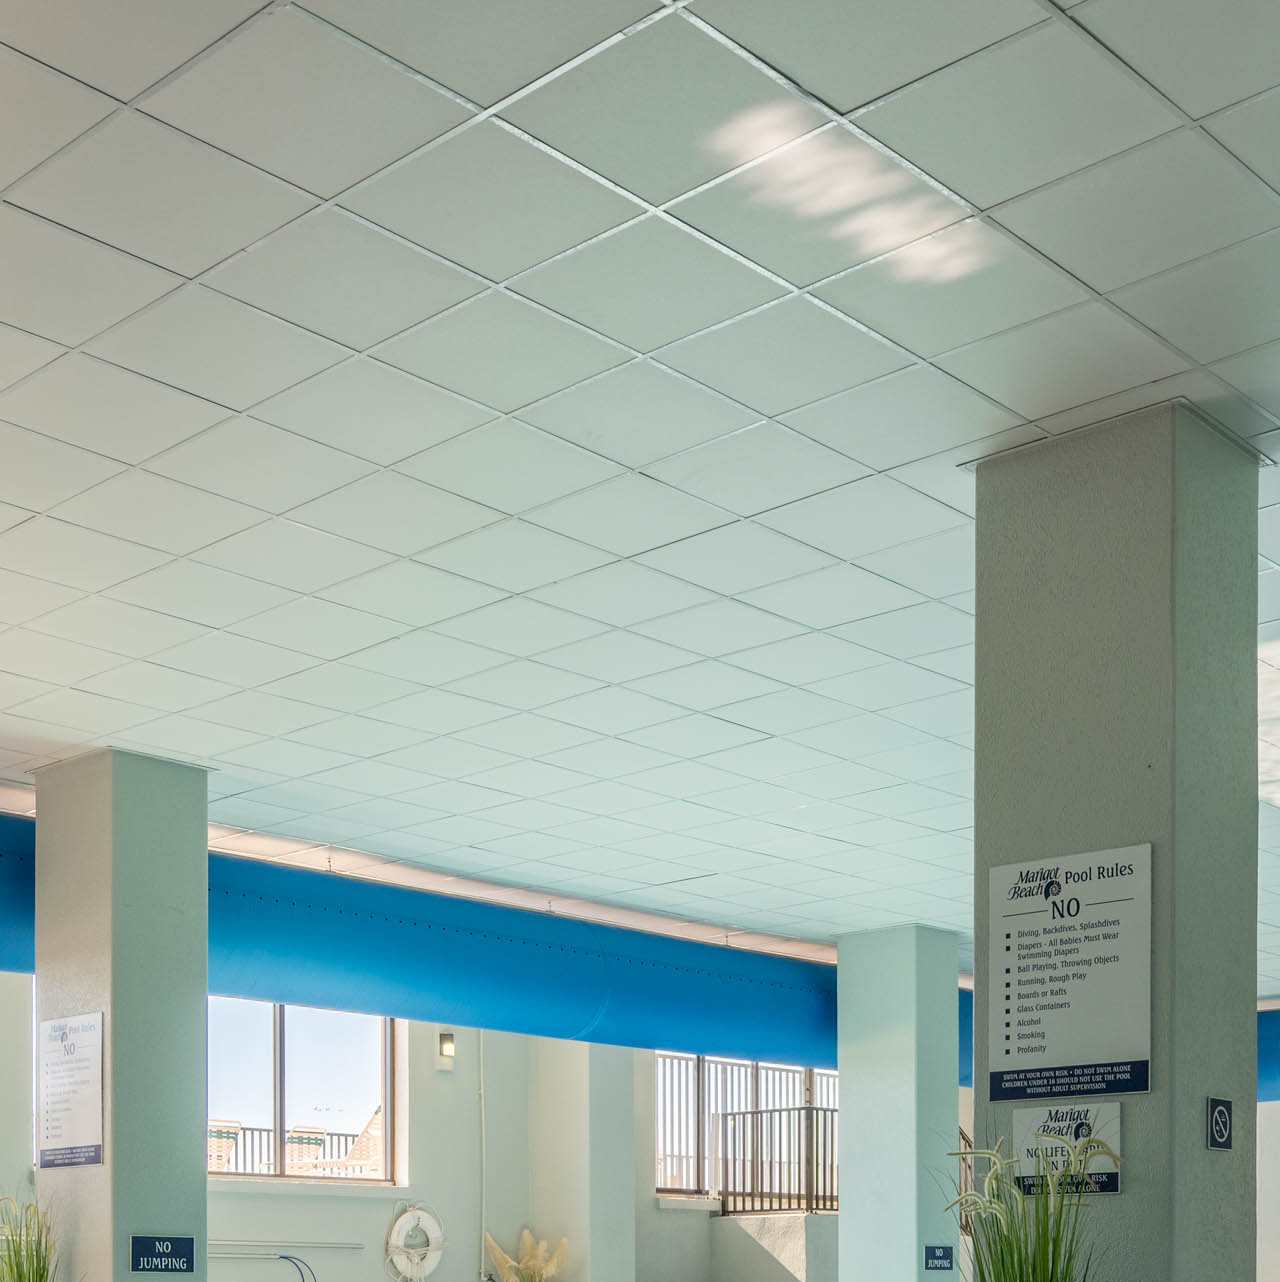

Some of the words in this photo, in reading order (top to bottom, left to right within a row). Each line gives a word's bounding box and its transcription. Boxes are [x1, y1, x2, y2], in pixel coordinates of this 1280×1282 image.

[1013, 866, 1060, 886] Marigot
[1064, 866, 1092, 884] Pool
[1097, 862, 1134, 880] Rules
[1005, 882, 1044, 901] Beach
[1051, 897, 1080, 919] NO
[1079, 919, 1120, 931] Splashdives
[1017, 941, 1042, 952] Diapers
[1048, 937, 1058, 947] All
[1059, 936, 1082, 946] Babies
[1083, 933, 1100, 943] Must
[1101, 931, 1119, 941] Wear
[1017, 950, 1052, 961] Swimming
[1054, 946, 1080, 957] Diapers
[1017, 964, 1030, 974] Ball
[1061, 957, 1092, 969] Throwing
[1094, 954, 1120, 965] Objects
[1048, 972, 1070, 983] Rough
[1072, 971, 1087, 981] Play
[1017, 990, 1040, 1000] Boards
[1050, 987, 1067, 997] Rafts
[1017, 1005, 1034, 1014] Glass
[1035, 1000, 1071, 1012] Containers
[1017, 1017, 1041, 1027] Alcohol
[1017, 1030, 1046, 1040] Smoking
[63, 1042, 76, 1057] NO
[1017, 1044, 1047, 1055] Profanity
[1112, 1065, 1131, 1073] ALONE
[1043, 1108, 1090, 1124] Marigot
[1091, 1174, 1108, 1182] RISK
[155, 1241, 172, 1253] NO
[935, 1247, 944, 1257] NO
[138, 1257, 187, 1269] JUMPING
[928, 1259, 951, 1268] JUMPING
